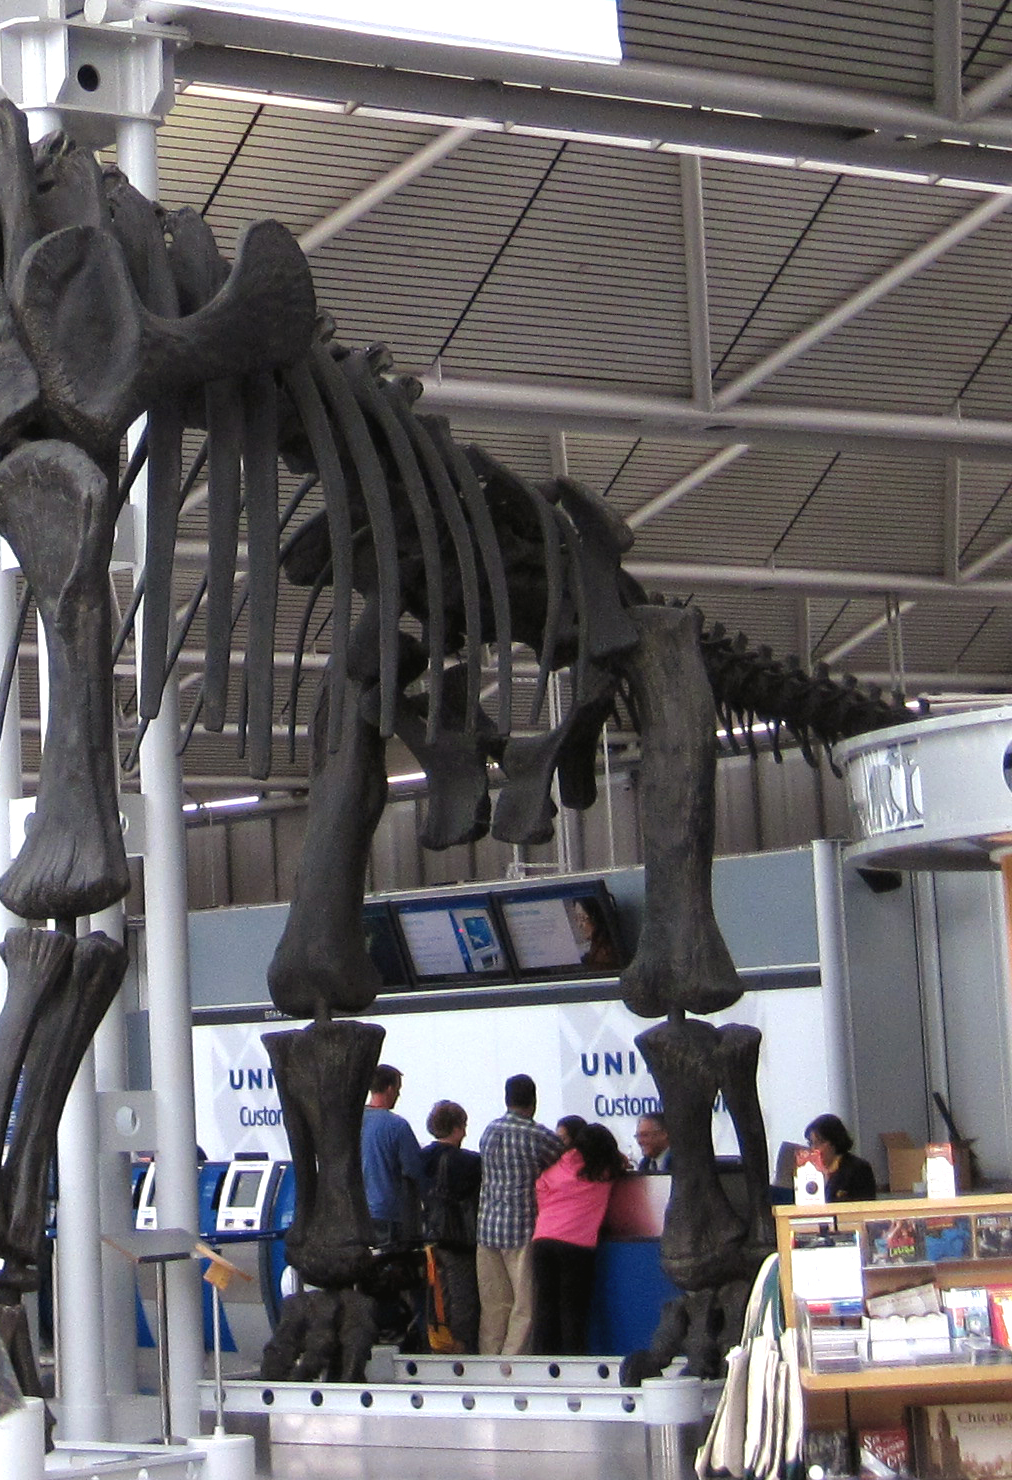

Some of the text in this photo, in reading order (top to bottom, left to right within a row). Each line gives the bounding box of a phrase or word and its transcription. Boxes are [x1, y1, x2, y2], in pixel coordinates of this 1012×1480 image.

[581, 1051, 637, 1077] UNI
[229, 1068, 274, 1090] UNI
[595, 1094, 659, 1117] Custom
